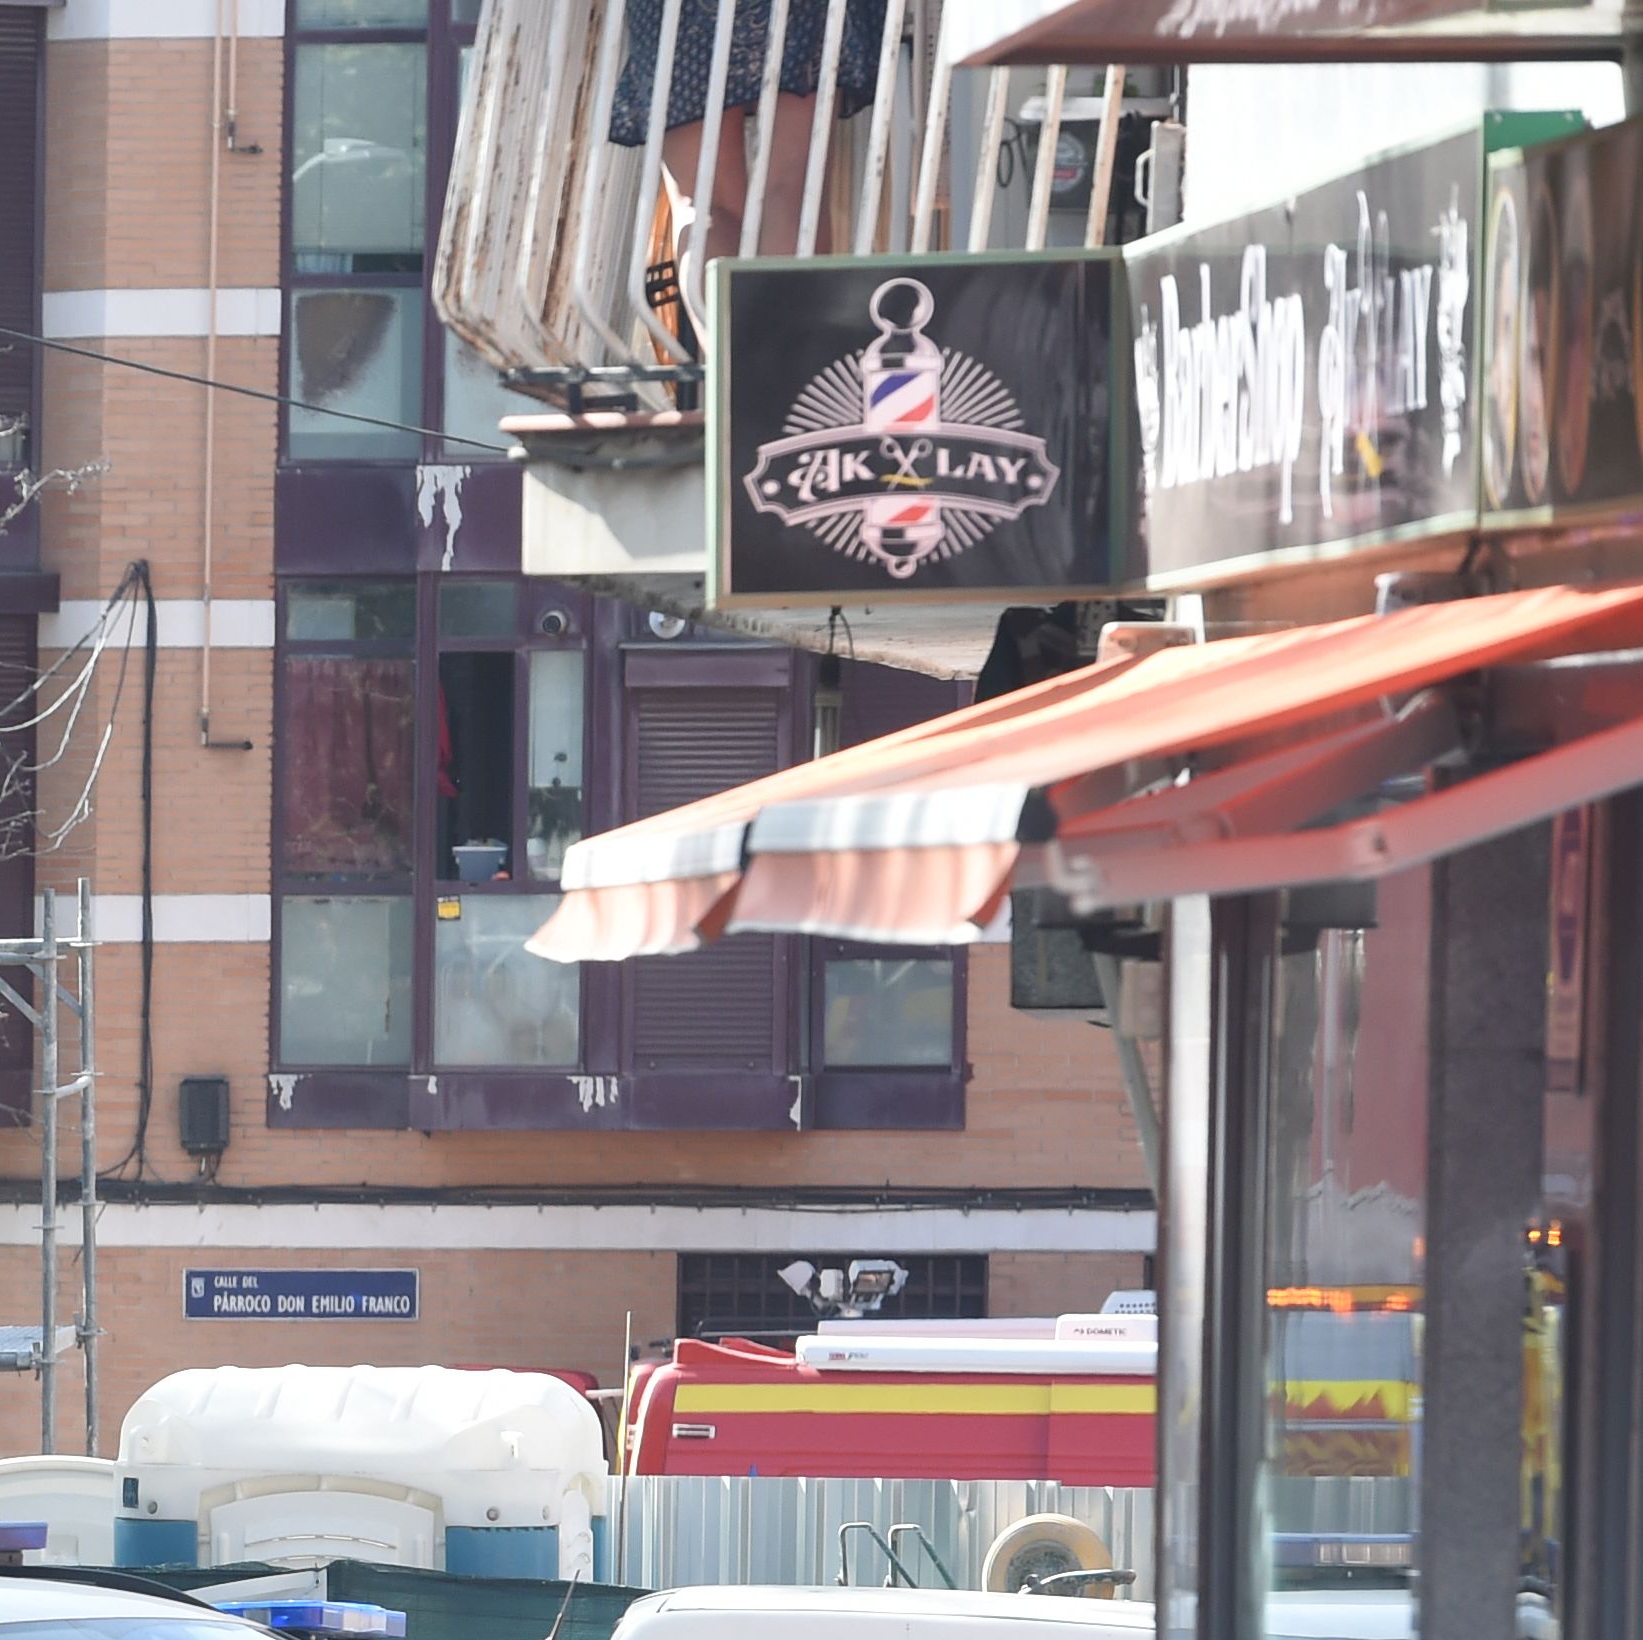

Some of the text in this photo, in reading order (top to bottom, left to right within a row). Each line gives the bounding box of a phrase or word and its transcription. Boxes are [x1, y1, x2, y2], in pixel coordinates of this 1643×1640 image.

[213, 1276, 259, 1289] CALLE DEL
[213, 1291, 411, 1314] PÁRROCO DON EMILIO FRANCO
